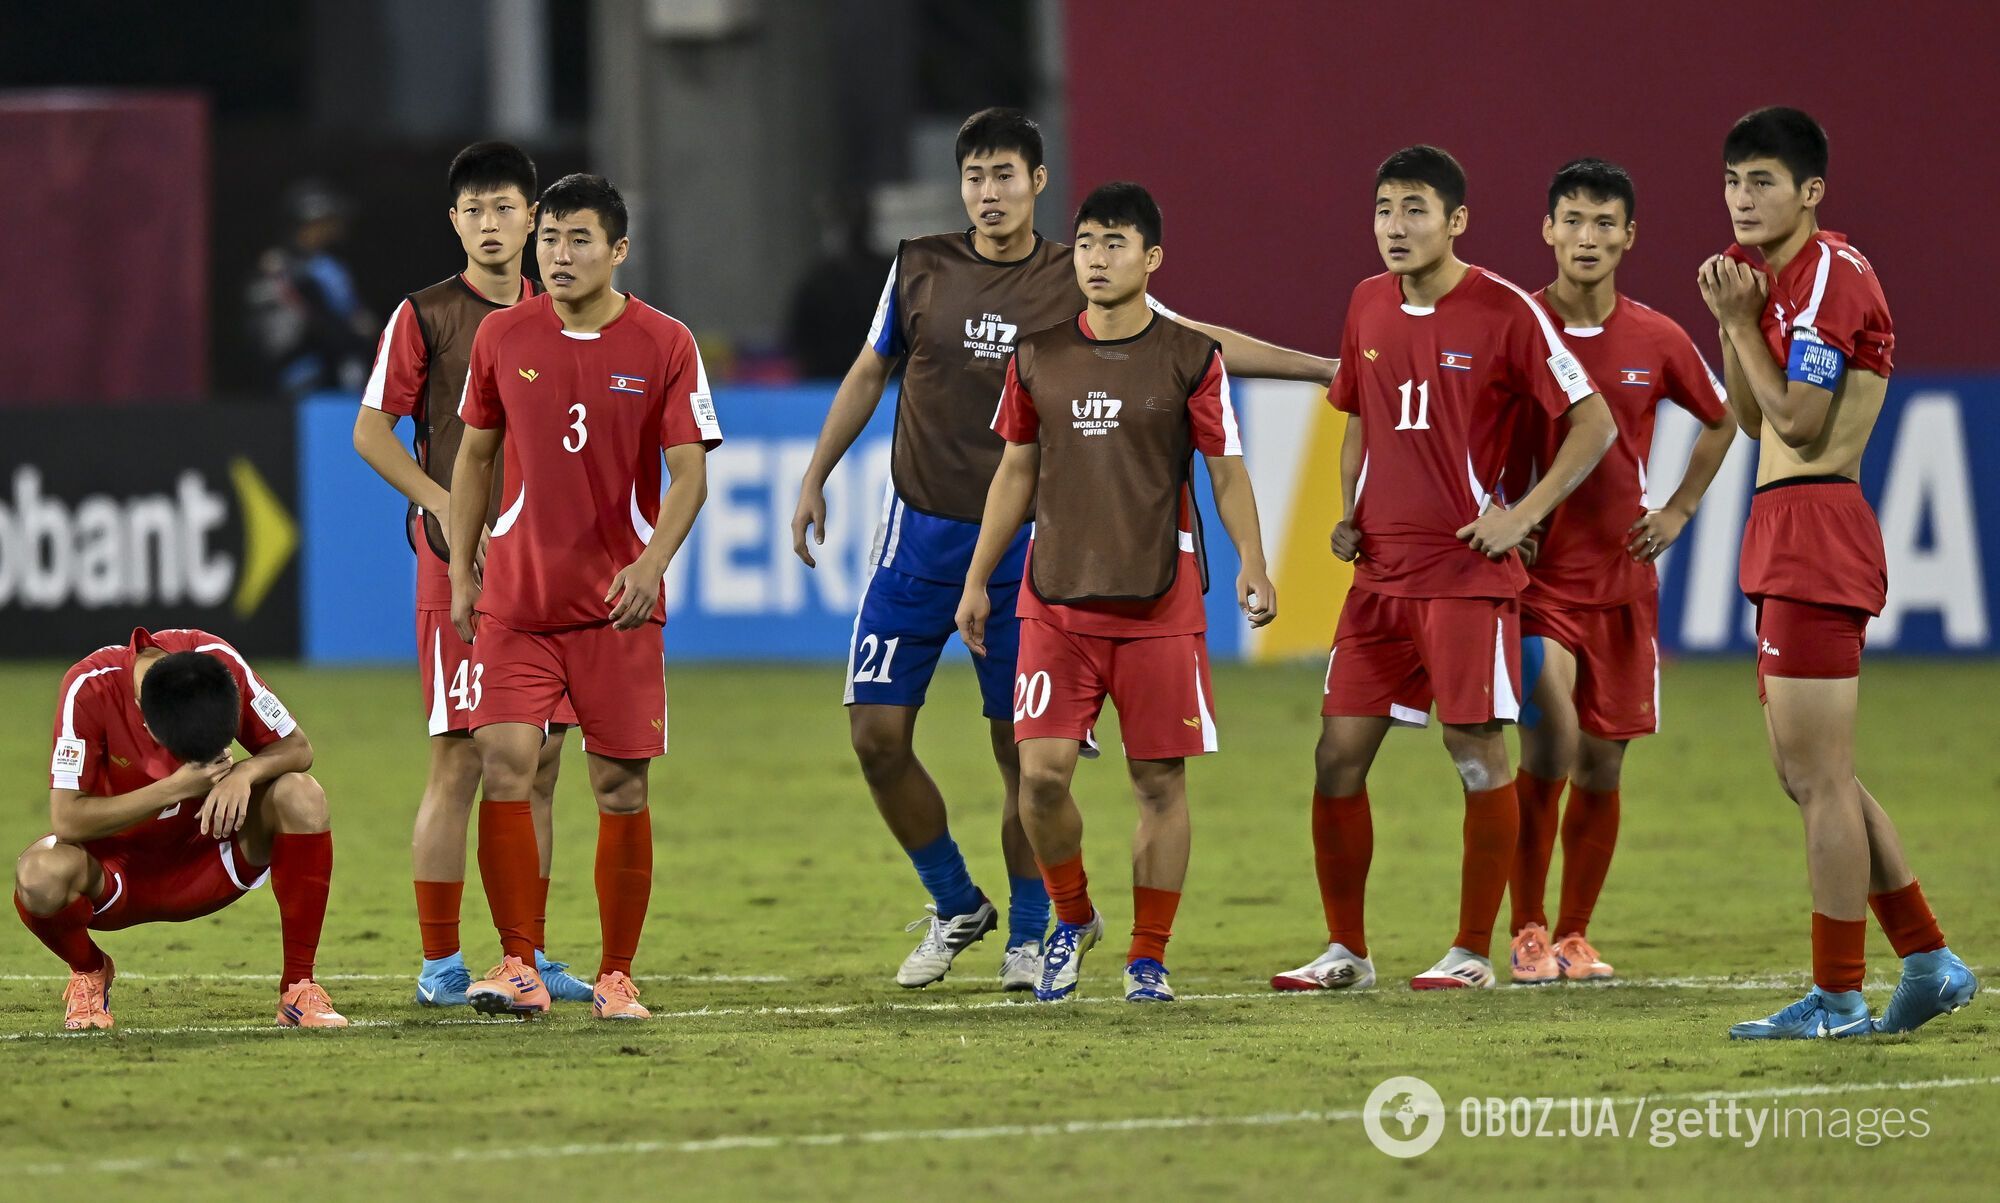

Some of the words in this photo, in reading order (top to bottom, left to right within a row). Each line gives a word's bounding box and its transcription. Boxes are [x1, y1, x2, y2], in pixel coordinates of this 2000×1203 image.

[983, 313, 1002, 322] FIFA
[965, 319, 1017, 343] U17
[963, 340, 995, 350] WORLD
[974, 350, 1001, 359] QATAR
[1806, 344, 1838, 360] FOOTBALL
[1803, 352, 1837, 371] UNITES
[1088, 391, 1107, 399] FIFA
[1072, 399, 1122, 420] U17
[1395, 380, 1430, 430] 11
[563, 403, 588, 453] 3
[1072, 421, 1101, 429] WORLD
[1102, 420, 1119, 428] CUP
[1083, 428, 1107, 437] QATAR
[0, 465, 234, 607] bant
[853, 634, 899, 683] 21
[1013, 670, 1051, 724] 20
